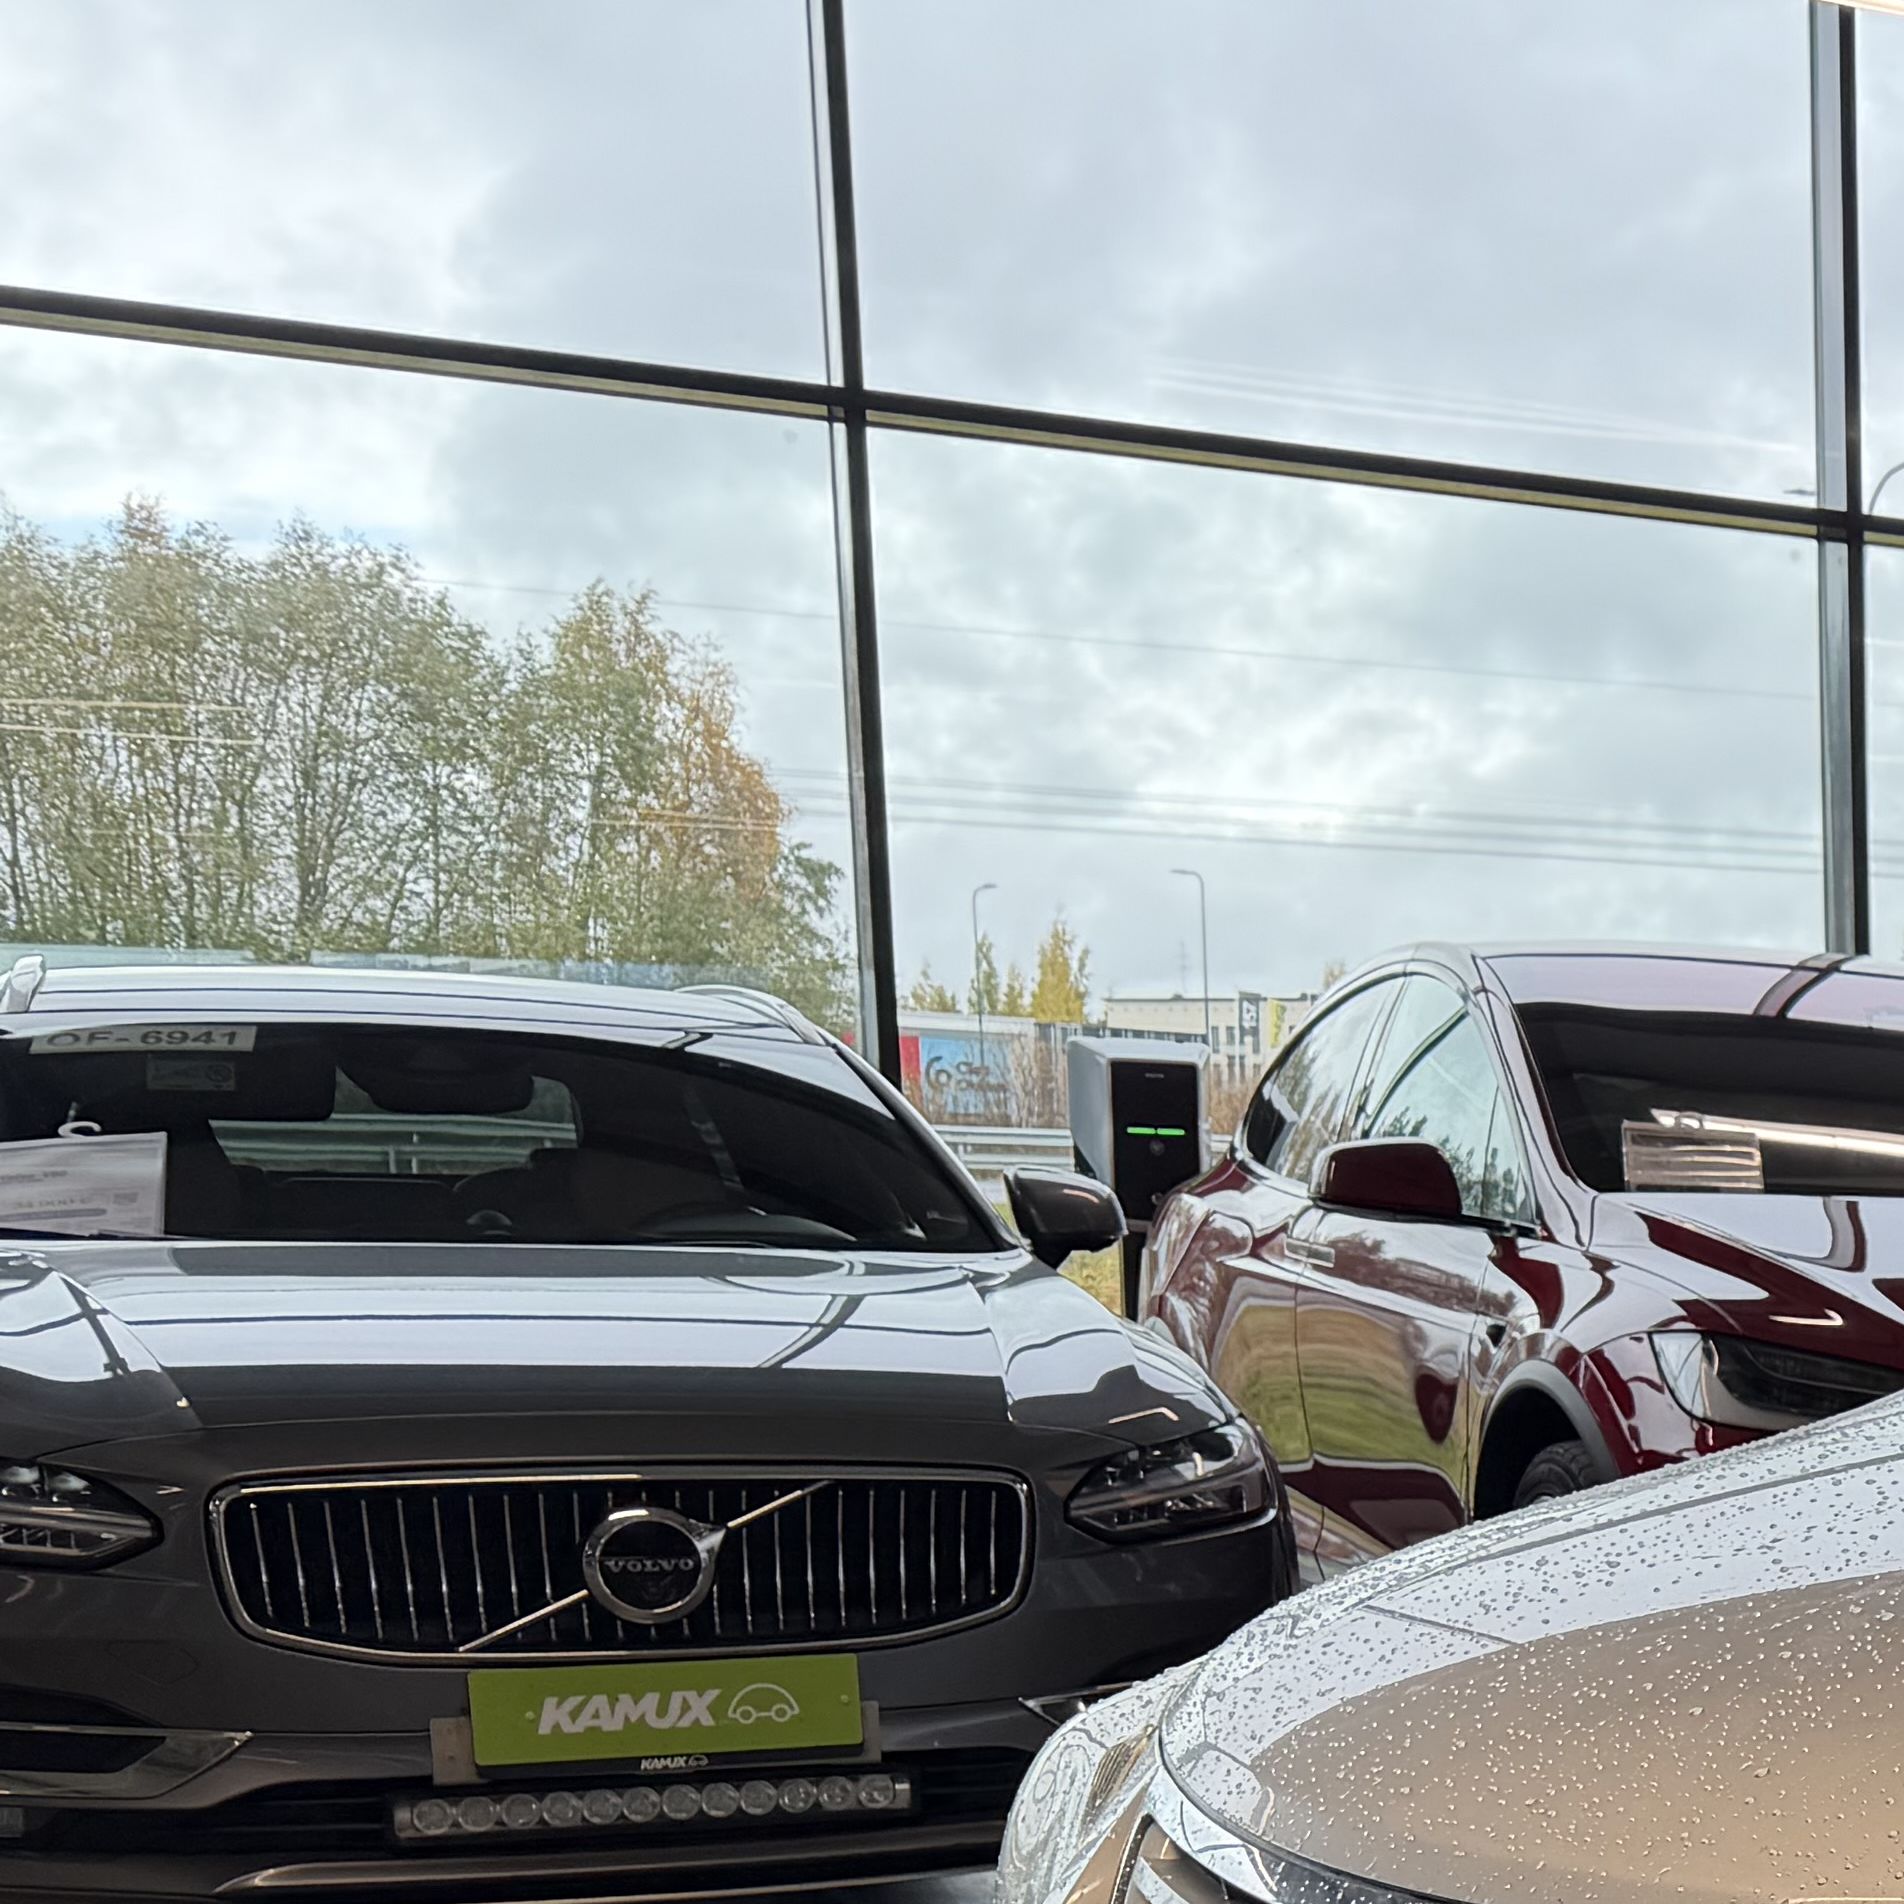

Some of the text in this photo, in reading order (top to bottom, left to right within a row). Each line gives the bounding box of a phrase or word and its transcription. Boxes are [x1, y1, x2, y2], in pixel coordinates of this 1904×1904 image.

[604, 1557, 695, 1573] VOLVO
[538, 1689, 722, 1735] KAMUX
[640, 1755, 688, 1771] KAMUX
